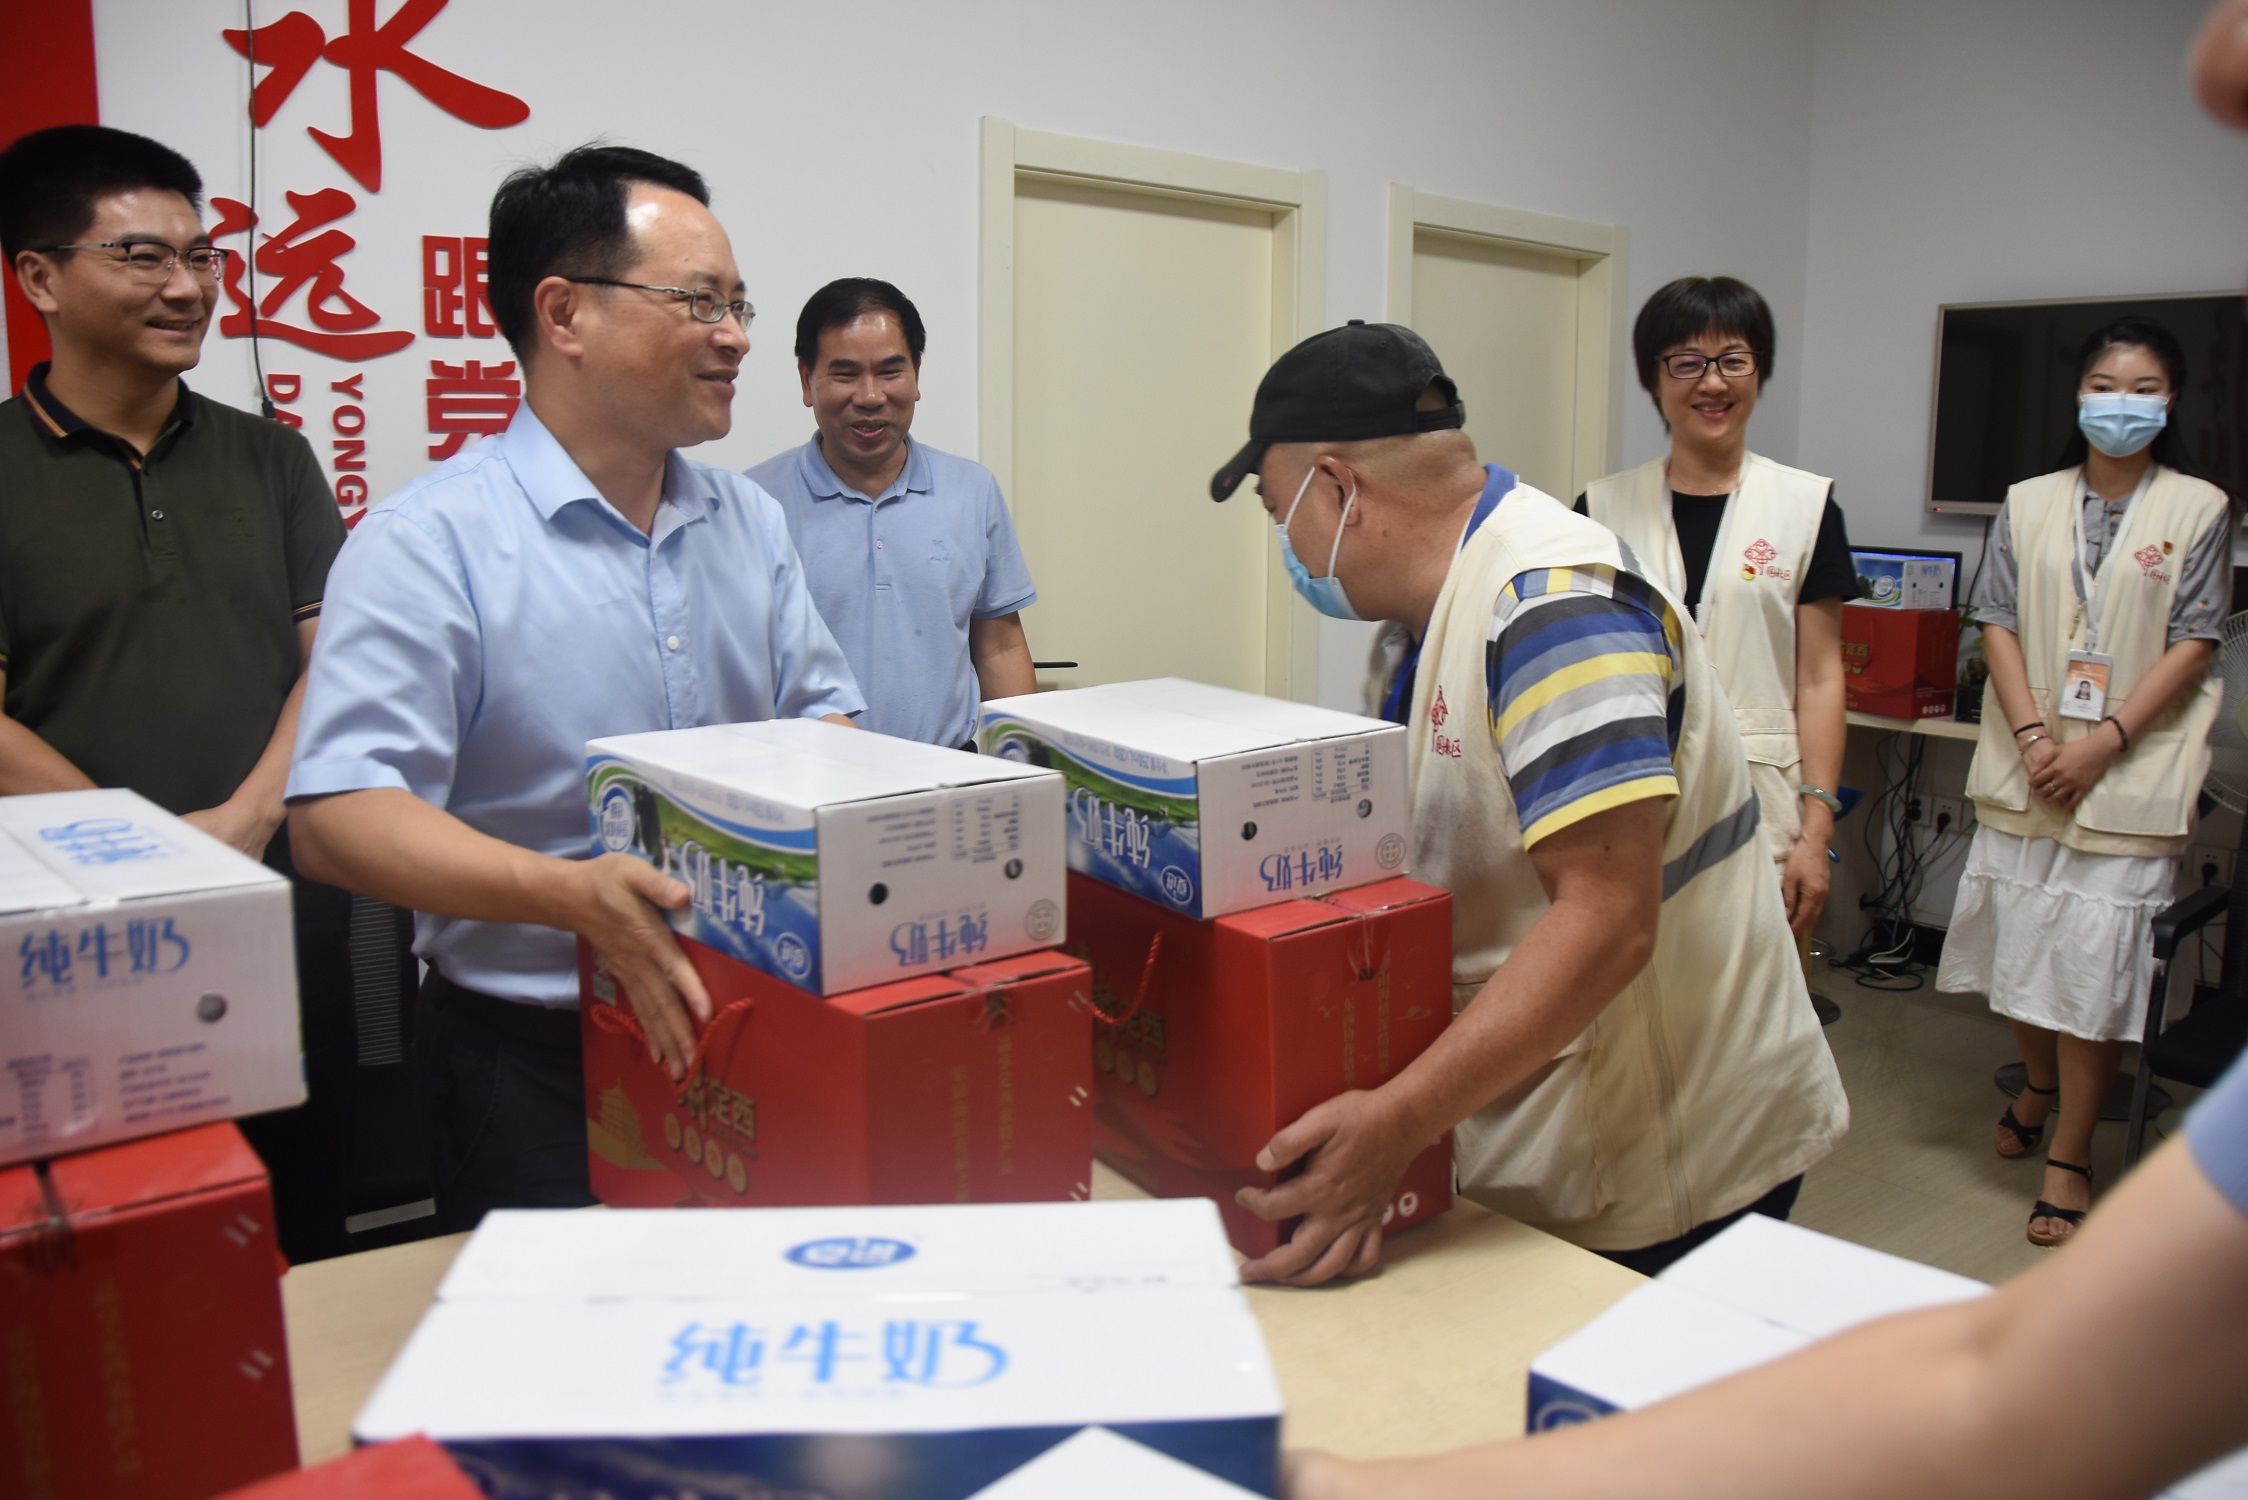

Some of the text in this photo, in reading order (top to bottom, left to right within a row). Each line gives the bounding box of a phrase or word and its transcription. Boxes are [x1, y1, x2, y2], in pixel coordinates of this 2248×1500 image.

[1073, 786, 1151, 869] 纯牛奶
[681, 840, 766, 937] 纯牛奶
[1259, 845, 1344, 892] 纯牛奶
[19, 916, 191, 986] 纯牛奶
[890, 911, 988, 967] 纯牛奶
[658, 1319, 1010, 1389] 纯牛奶
